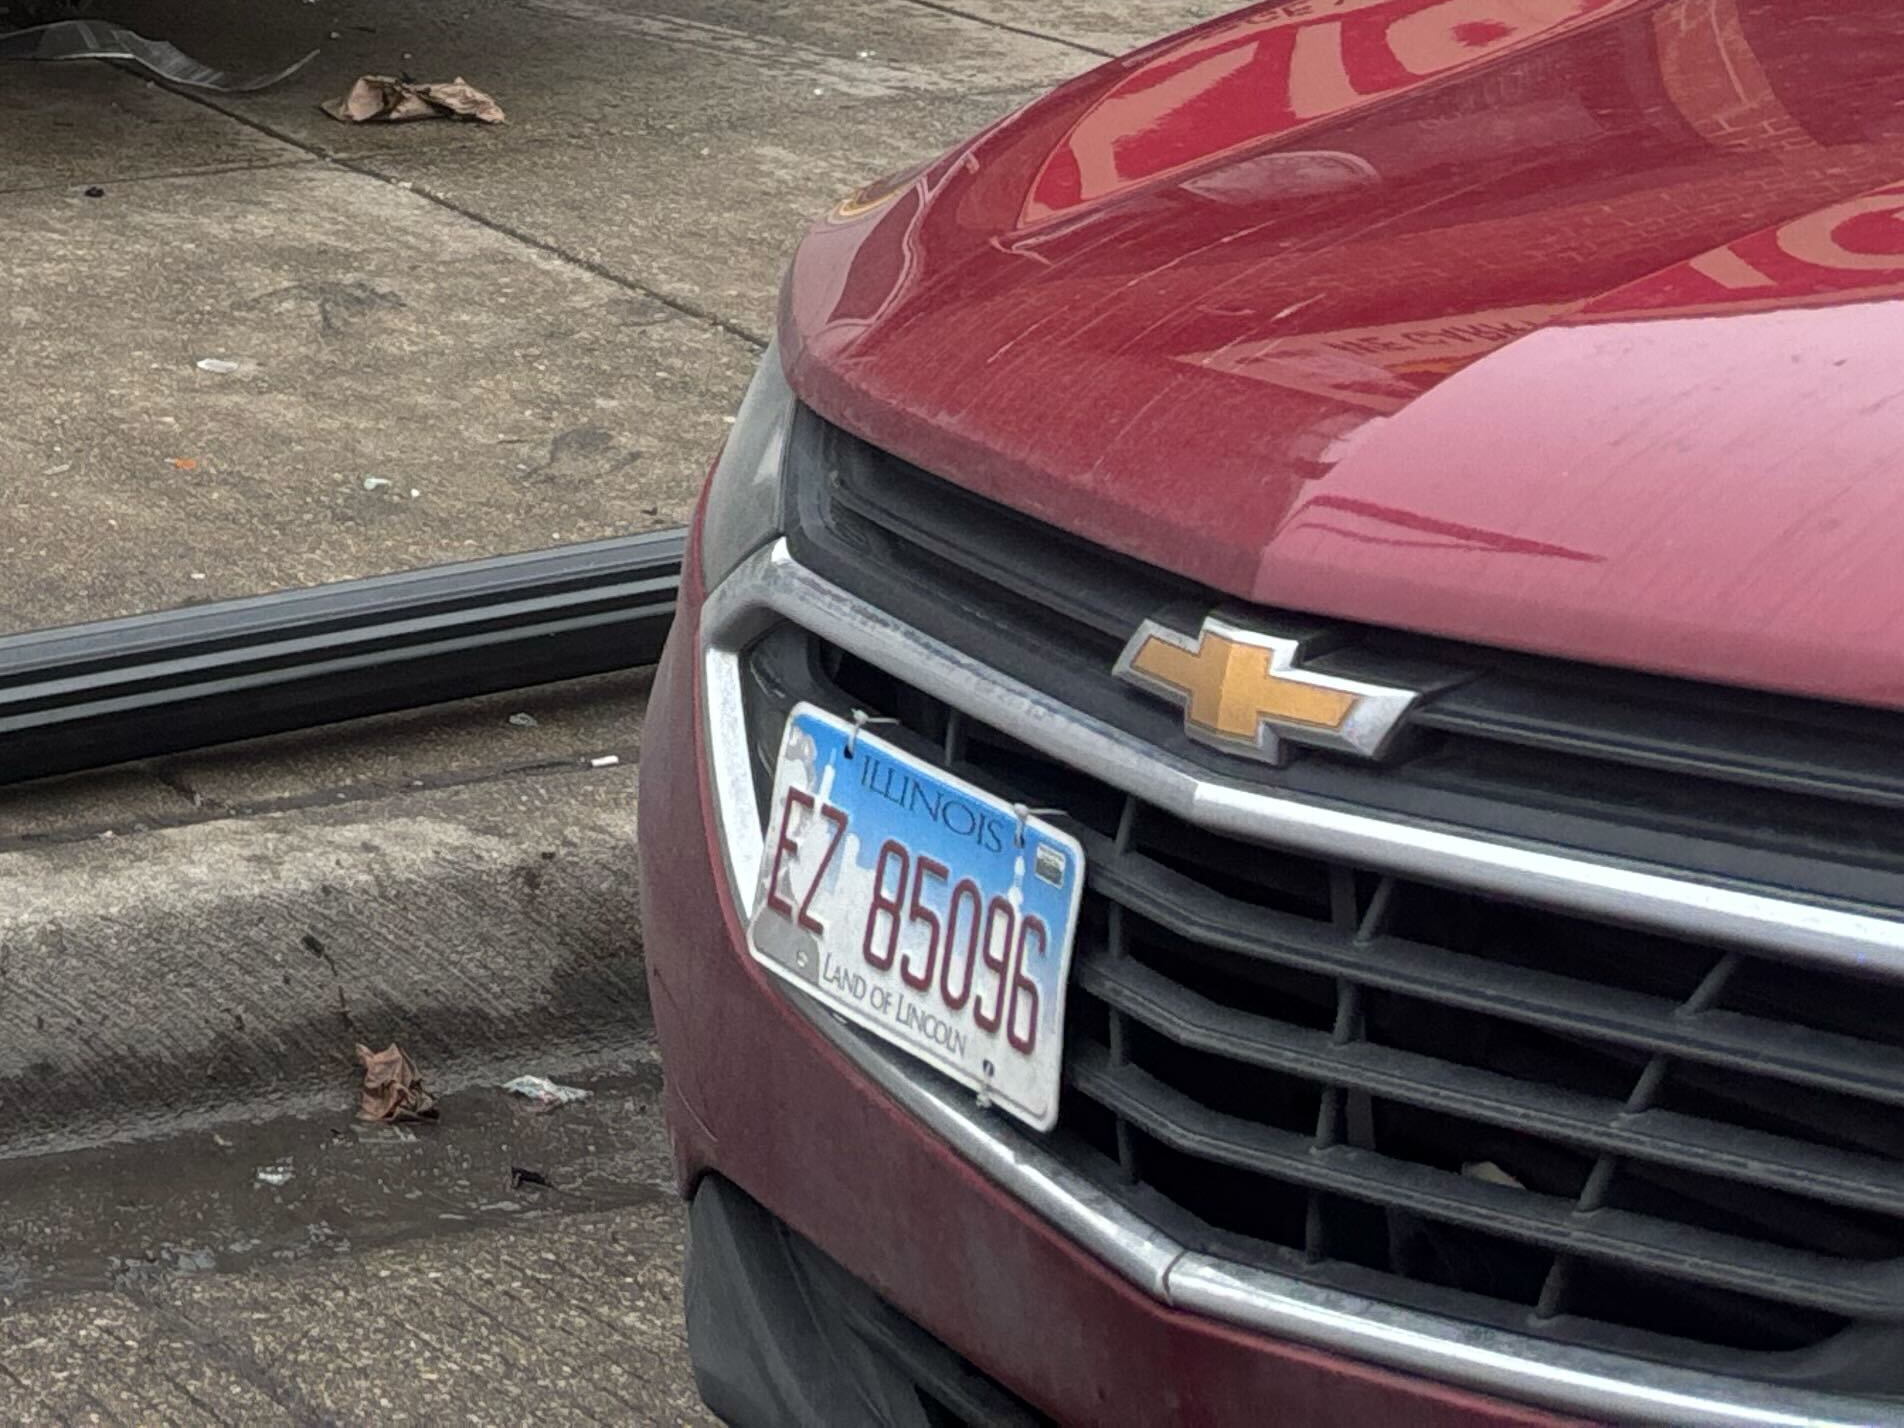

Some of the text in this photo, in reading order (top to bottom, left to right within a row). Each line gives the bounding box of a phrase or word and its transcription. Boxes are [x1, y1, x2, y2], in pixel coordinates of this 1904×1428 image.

[860, 754, 1003, 854] ILLINOIS
[767, 785, 1047, 1056] EZ 85096
[822, 950, 967, 1058] LAND OF LINCOLN
